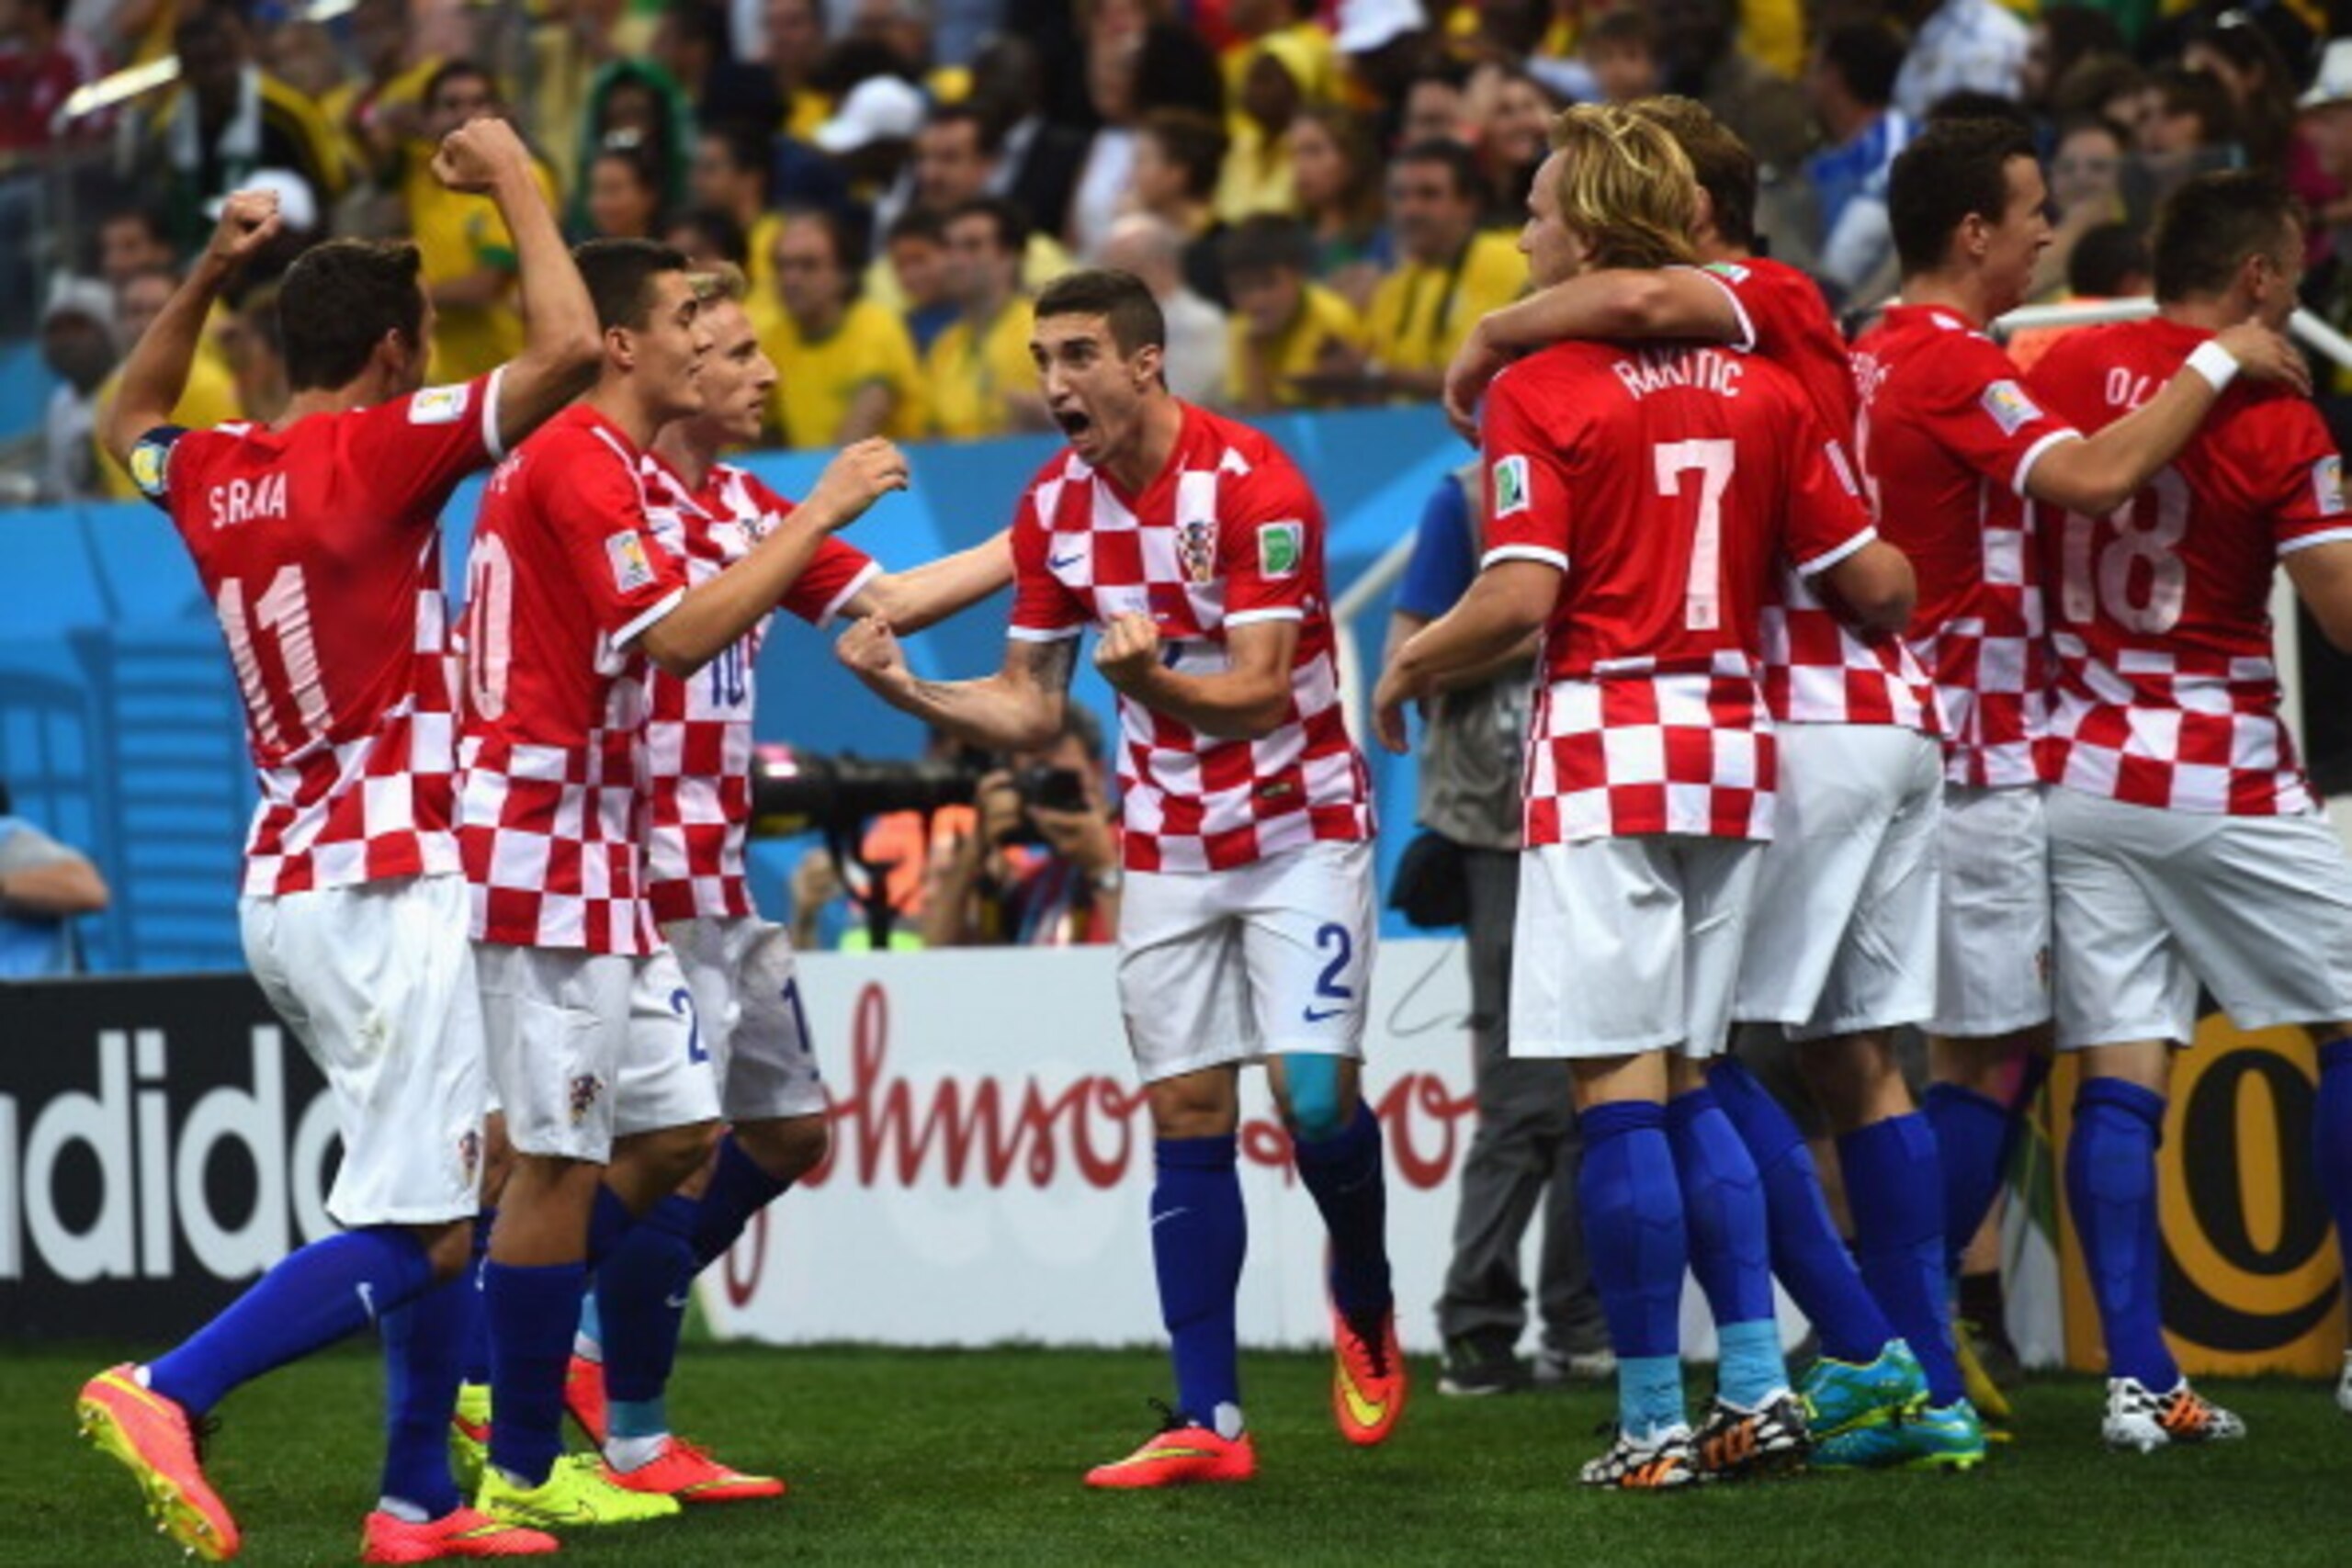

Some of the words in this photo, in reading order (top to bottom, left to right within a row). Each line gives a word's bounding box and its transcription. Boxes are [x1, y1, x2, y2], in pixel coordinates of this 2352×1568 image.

[1654, 439, 1736, 630] 7
[2063, 462, 2189, 634] 18
[217, 563, 334, 753] 11
[1315, 922, 1351, 998] 2
